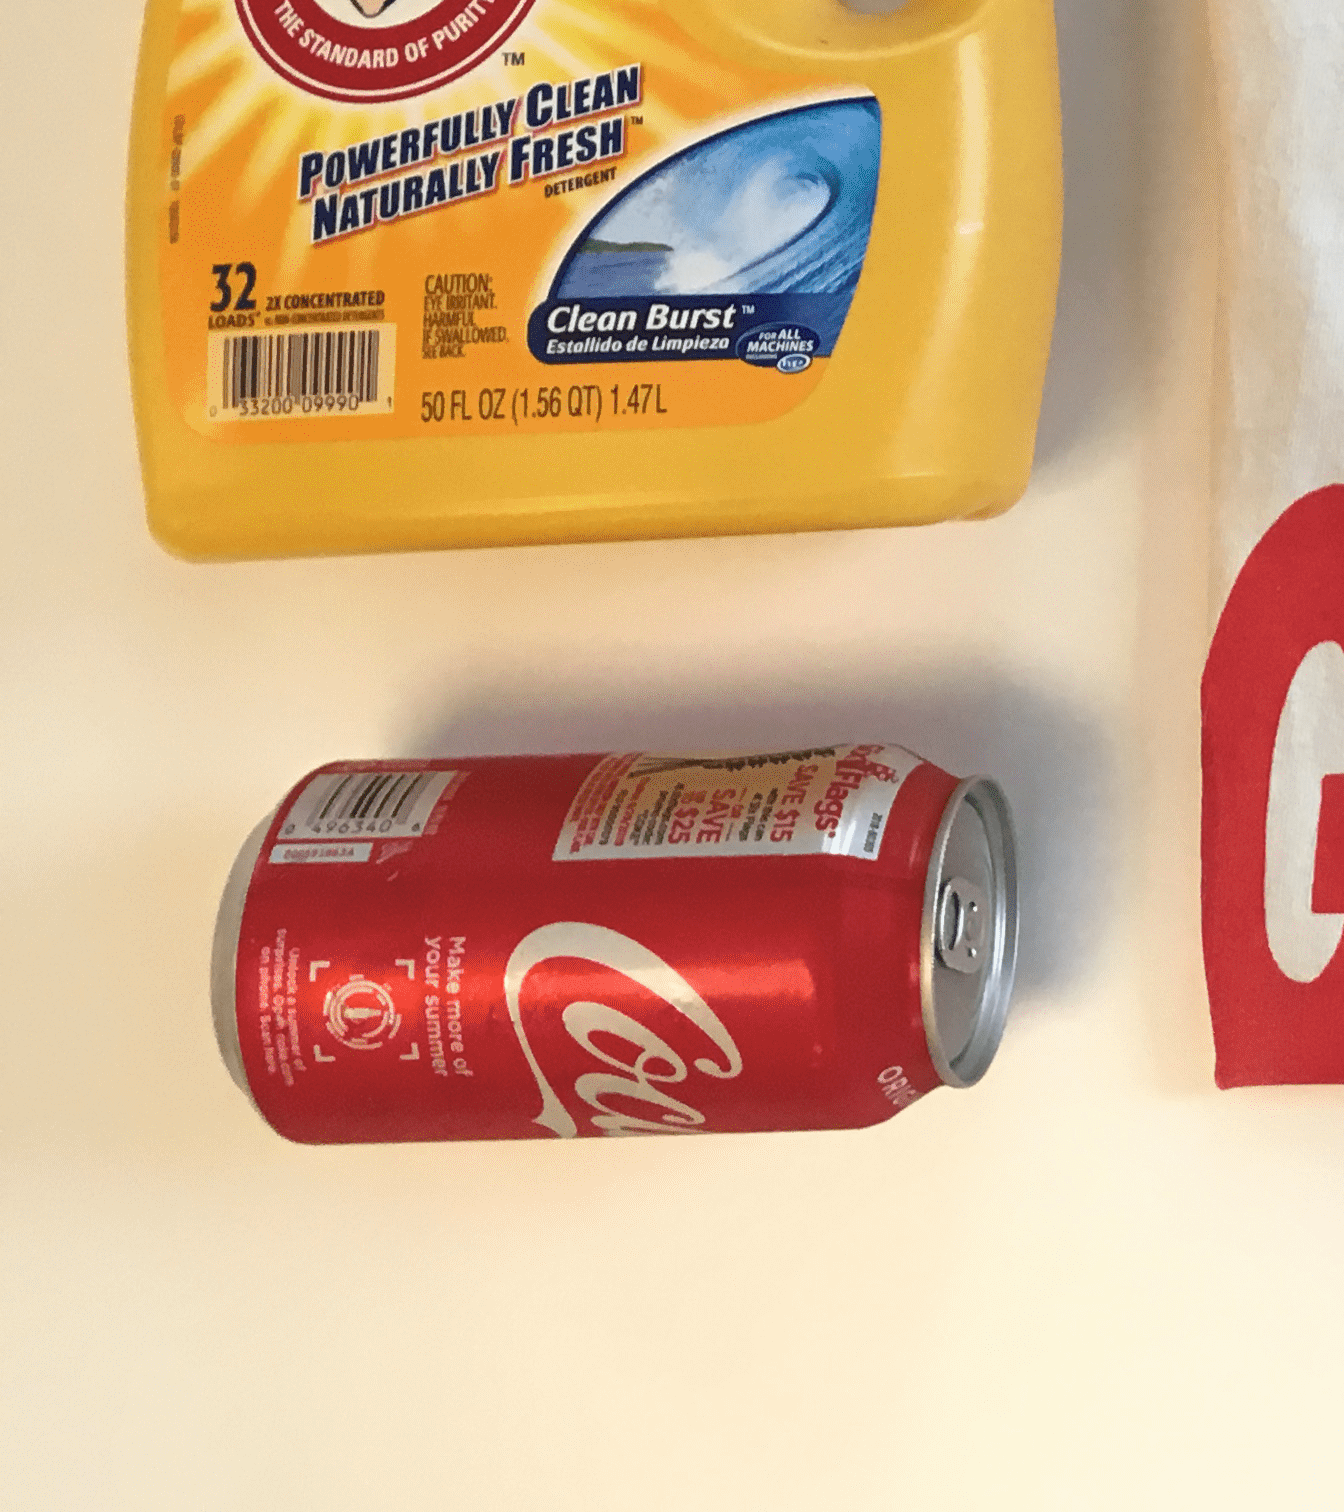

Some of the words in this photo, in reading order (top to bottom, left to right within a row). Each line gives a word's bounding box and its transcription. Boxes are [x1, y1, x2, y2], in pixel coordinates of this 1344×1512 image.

[298, 29, 399, 69] STANDARD
[405, 39, 430, 63] OF
[502, 51, 526, 67] TM
[298, 96, 519, 198] POWERFULLY
[525, 63, 642, 129] CLEAN
[312, 150, 501, 243] NATURALLY
[508, 116, 626, 184] FRESH
[543, 165, 618, 198] DETERGENT
[209, 261, 257, 313] 32
[284, 289, 386, 310] CONCENTRATED
[424, 272, 493, 295] CAUTION:
[547, 304, 638, 334] Clean
[645, 303, 737, 330] Burst
[758, 331, 778, 341] FOR
[777, 328, 802, 341] ALL
[546, 337, 624, 355] Estallido
[626, 337, 648, 353] de
[651, 335, 731, 354] Limpieza
[747, 339, 815, 353] MACHINES
[238, 398, 293, 417] 33200
[301, 393, 360, 414] 09990
[420, 390, 446, 423] 50
[450, 389, 473, 421] FL
[478, 388, 507, 421] OZ
[511, 386, 563, 427] (1.56
[567, 384, 603, 424] QT)
[781, 764, 819, 806] SAVE
[813, 770, 862, 832] Flags
[667, 807, 700, 845] $25
[695, 788, 737, 844] SAVE
[769, 808, 801, 843] $15
[424, 935, 442, 989] your
[446, 935, 467, 995] Make
[425, 995, 449, 1078] summer
[447, 999, 464, 1054] more
[452, 1057, 474, 1078] of
